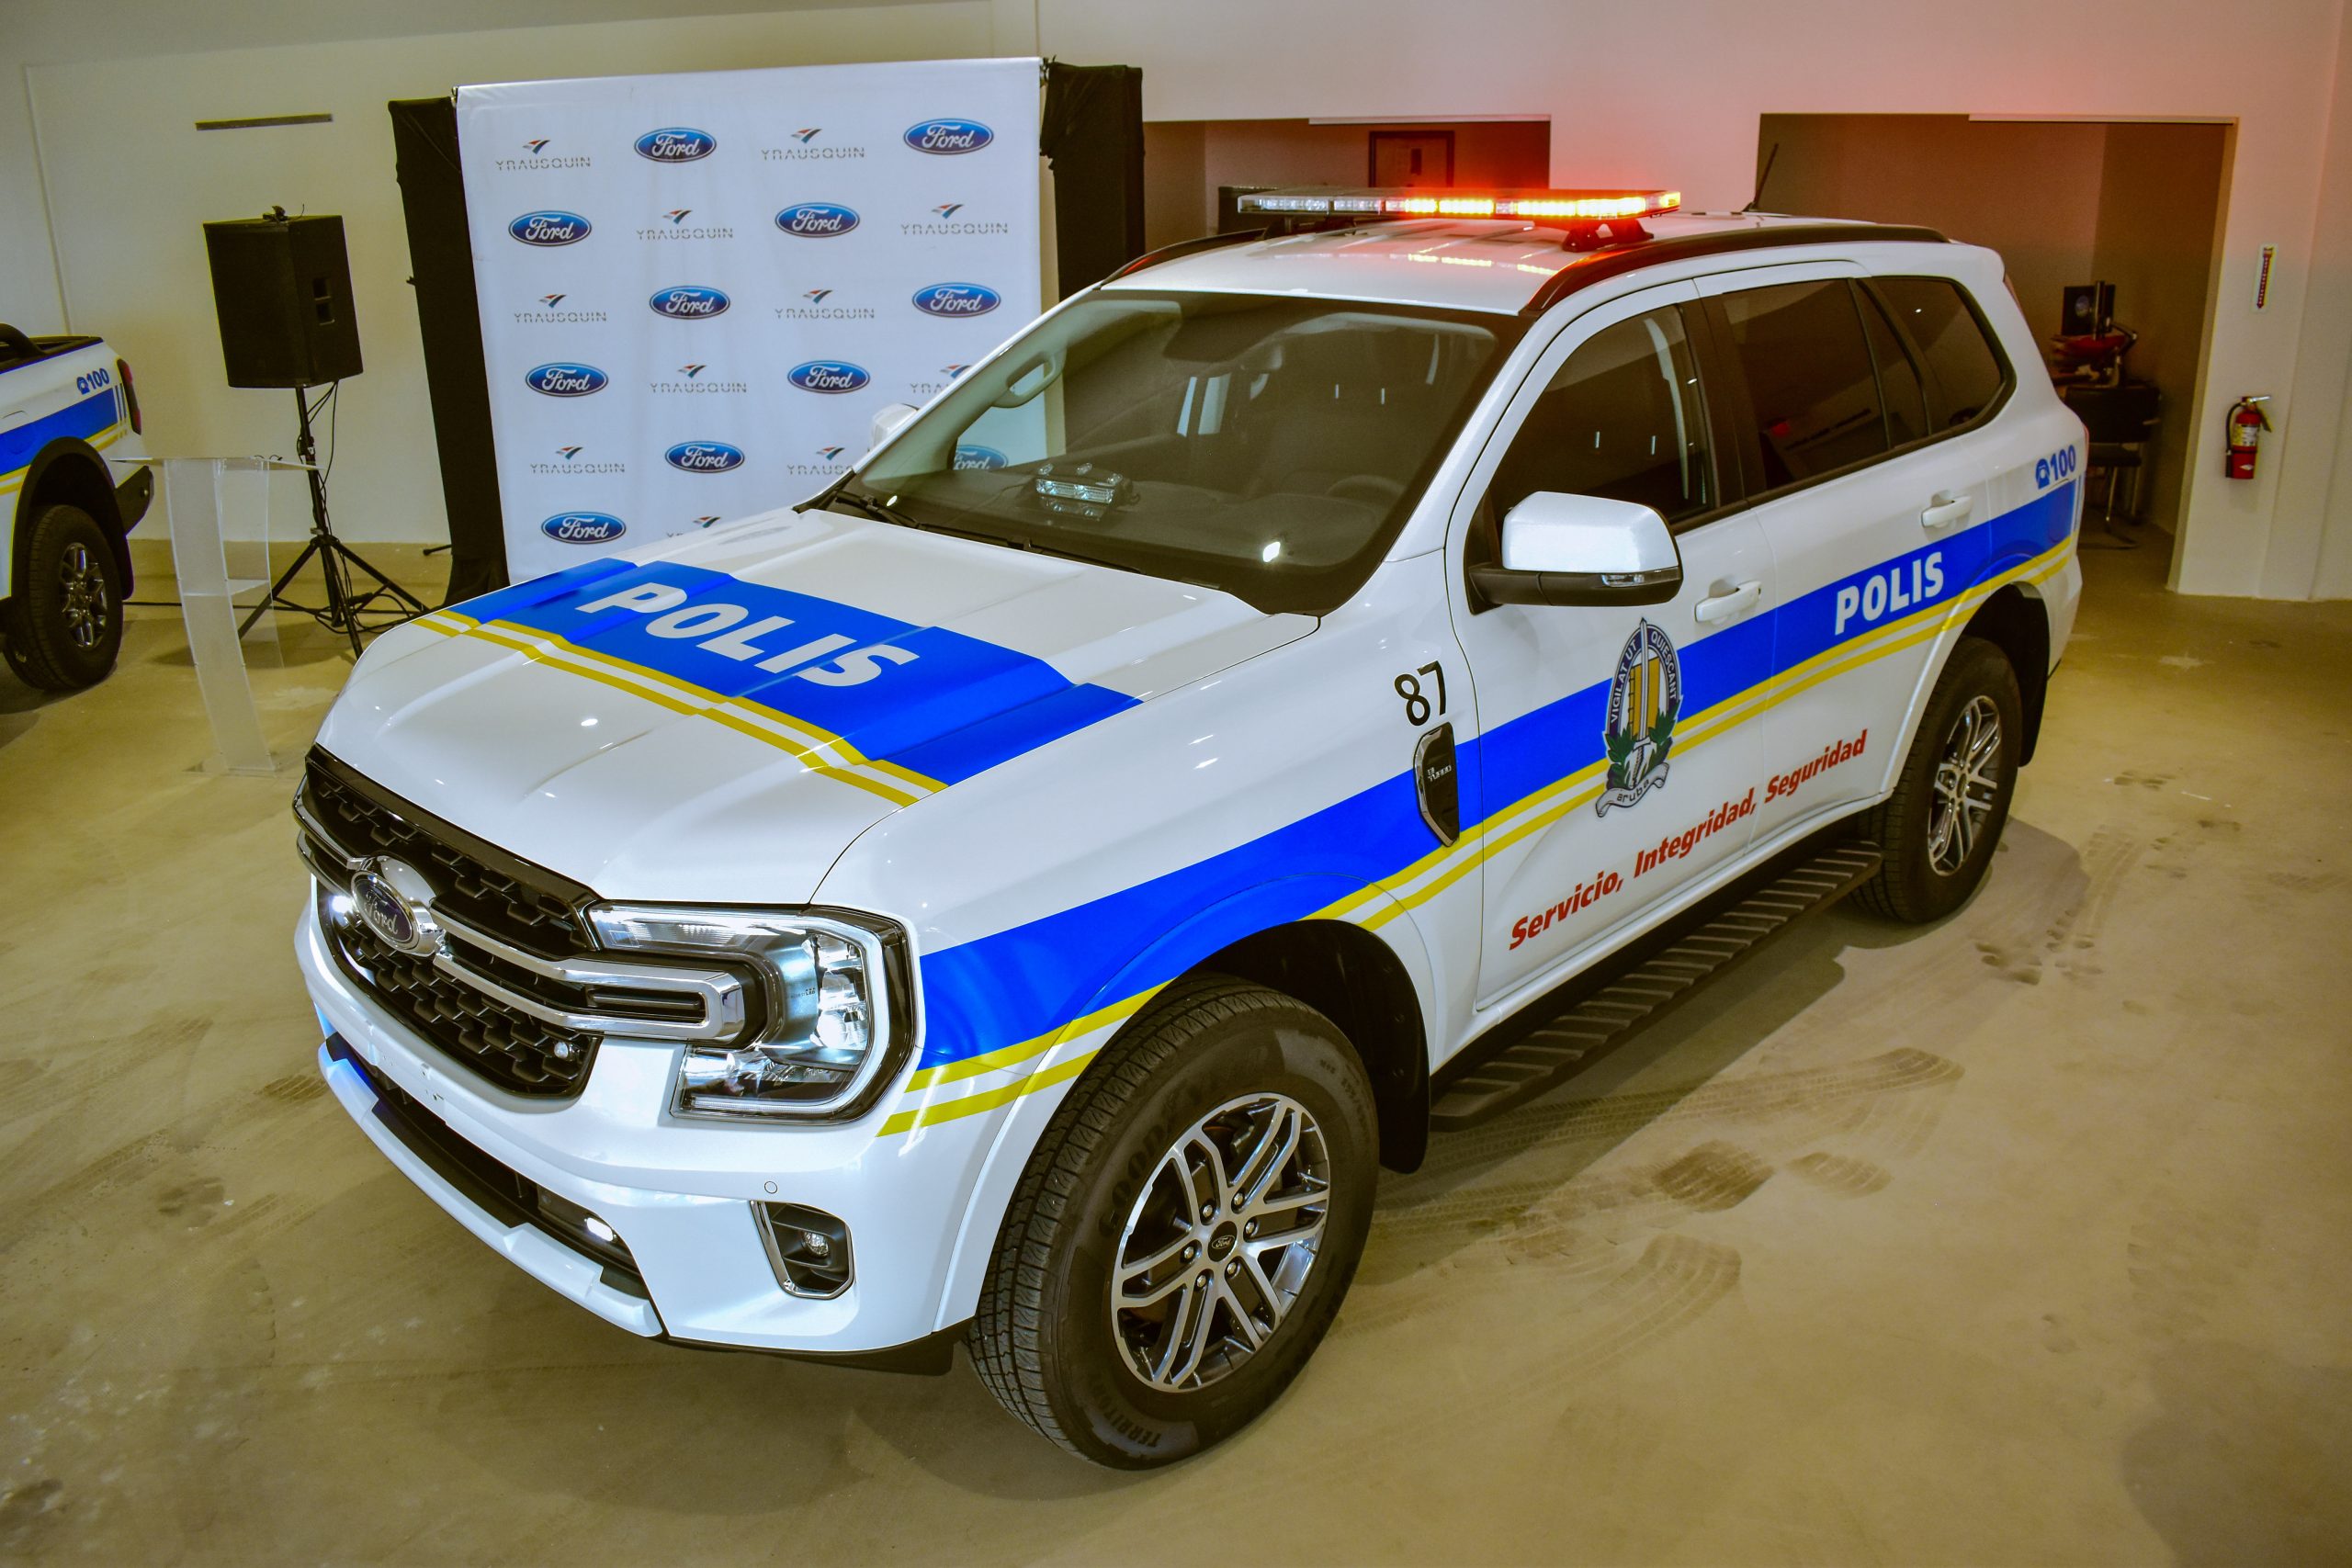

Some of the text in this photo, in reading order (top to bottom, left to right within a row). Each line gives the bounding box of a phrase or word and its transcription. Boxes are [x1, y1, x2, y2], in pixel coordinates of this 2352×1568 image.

[651, 132, 701, 157] Ford
[922, 124, 975, 149] Ford
[494, 156, 591, 171] YRAUSQUIN
[761, 147, 865, 161] YRAUSQUIN
[525, 216, 574, 241] Ford
[791, 208, 842, 232] Ford
[900, 222, 1008, 235] YRAUSQUIN
[637, 228, 733, 241] YRAUSQUIN
[665, 291, 715, 314] Ford
[929, 288, 982, 311] Ford
[514, 311, 607, 323] YRAUSQUIN
[775, 308, 875, 320] YRAUSQUIN
[86, 367, 110, 389] 100
[542, 367, 591, 391] Ford
[650, 382, 747, 393] YRAUSQUIN
[805, 366, 854, 389] Ford
[530, 463, 626, 474] YRAUSQUIN
[681, 446, 729, 468] Ford
[2051, 445, 2076, 480] 100
[787, 465, 853, 475] YRAUS
[558, 516, 609, 539] Ford
[1835, 551, 1944, 636] POLIS
[575, 581, 920, 687] POLIS
[1611, 630, 1677, 724] VIGILAT UT QUIESCANT
[1394, 660, 1446, 727] 87
[1616, 778, 1650, 803] aruba
[1509, 728, 1868, 950] Servicio, Integridad, Seguridad
[363, 888, 400, 935] Ford
